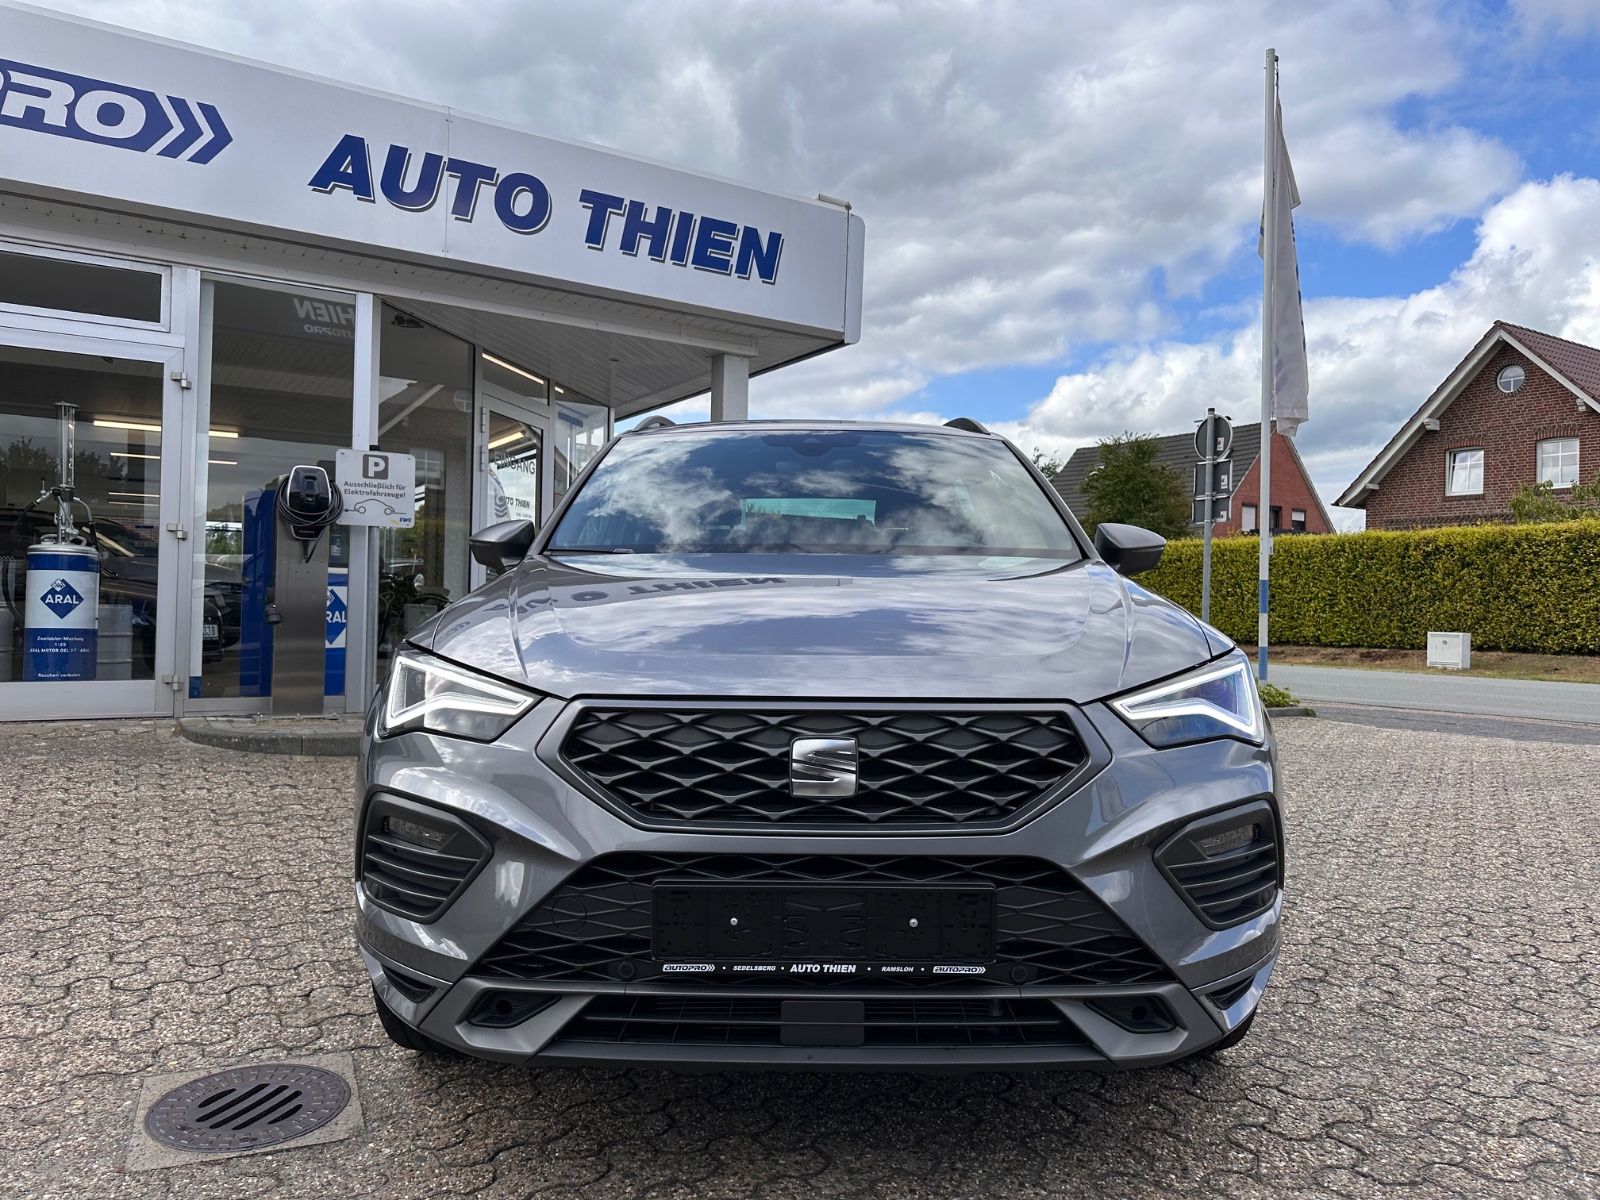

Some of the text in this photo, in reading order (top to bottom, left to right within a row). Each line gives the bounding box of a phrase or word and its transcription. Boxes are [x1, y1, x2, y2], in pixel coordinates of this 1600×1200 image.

[0, 69, 146, 139] RO
[308, 134, 784, 285] AUTO THIEN
[368, 456, 386, 477] P
[495, 451, 536, 475] EINGANG
[344, 481, 395, 490] Ausschließlich
[344, 488, 406, 499] Elektrofahrzeuge!
[45, 594, 79, 604] ARAL
[790, 964, 821, 973] AUTO
[822, 965, 857, 973] THIEN
